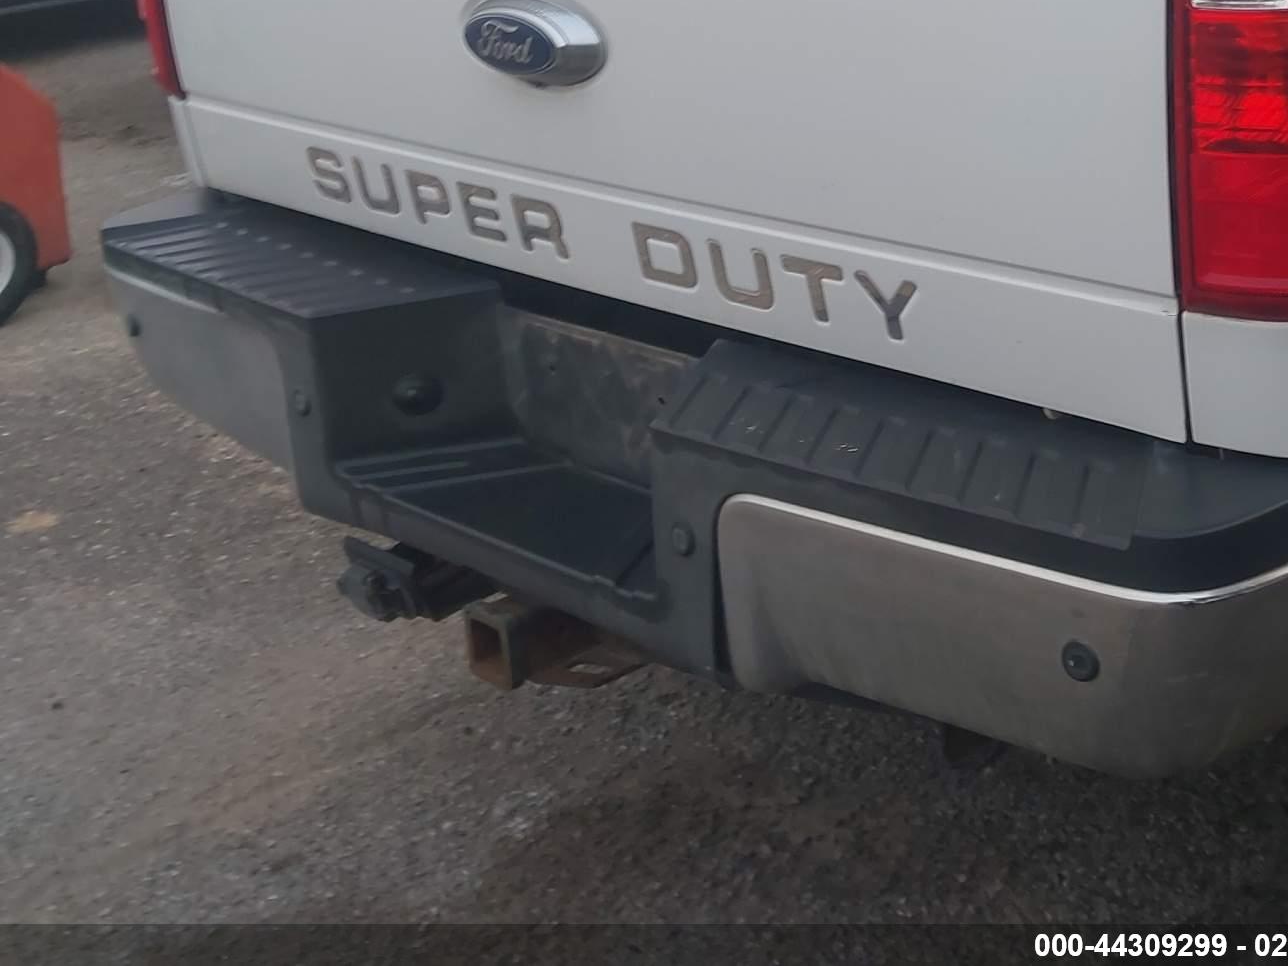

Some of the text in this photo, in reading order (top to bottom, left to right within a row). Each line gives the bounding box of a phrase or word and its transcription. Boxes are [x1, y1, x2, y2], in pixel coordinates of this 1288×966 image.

[475, 17, 534, 65] Ford
[306, 145, 918, 341] SUPER DUTY
